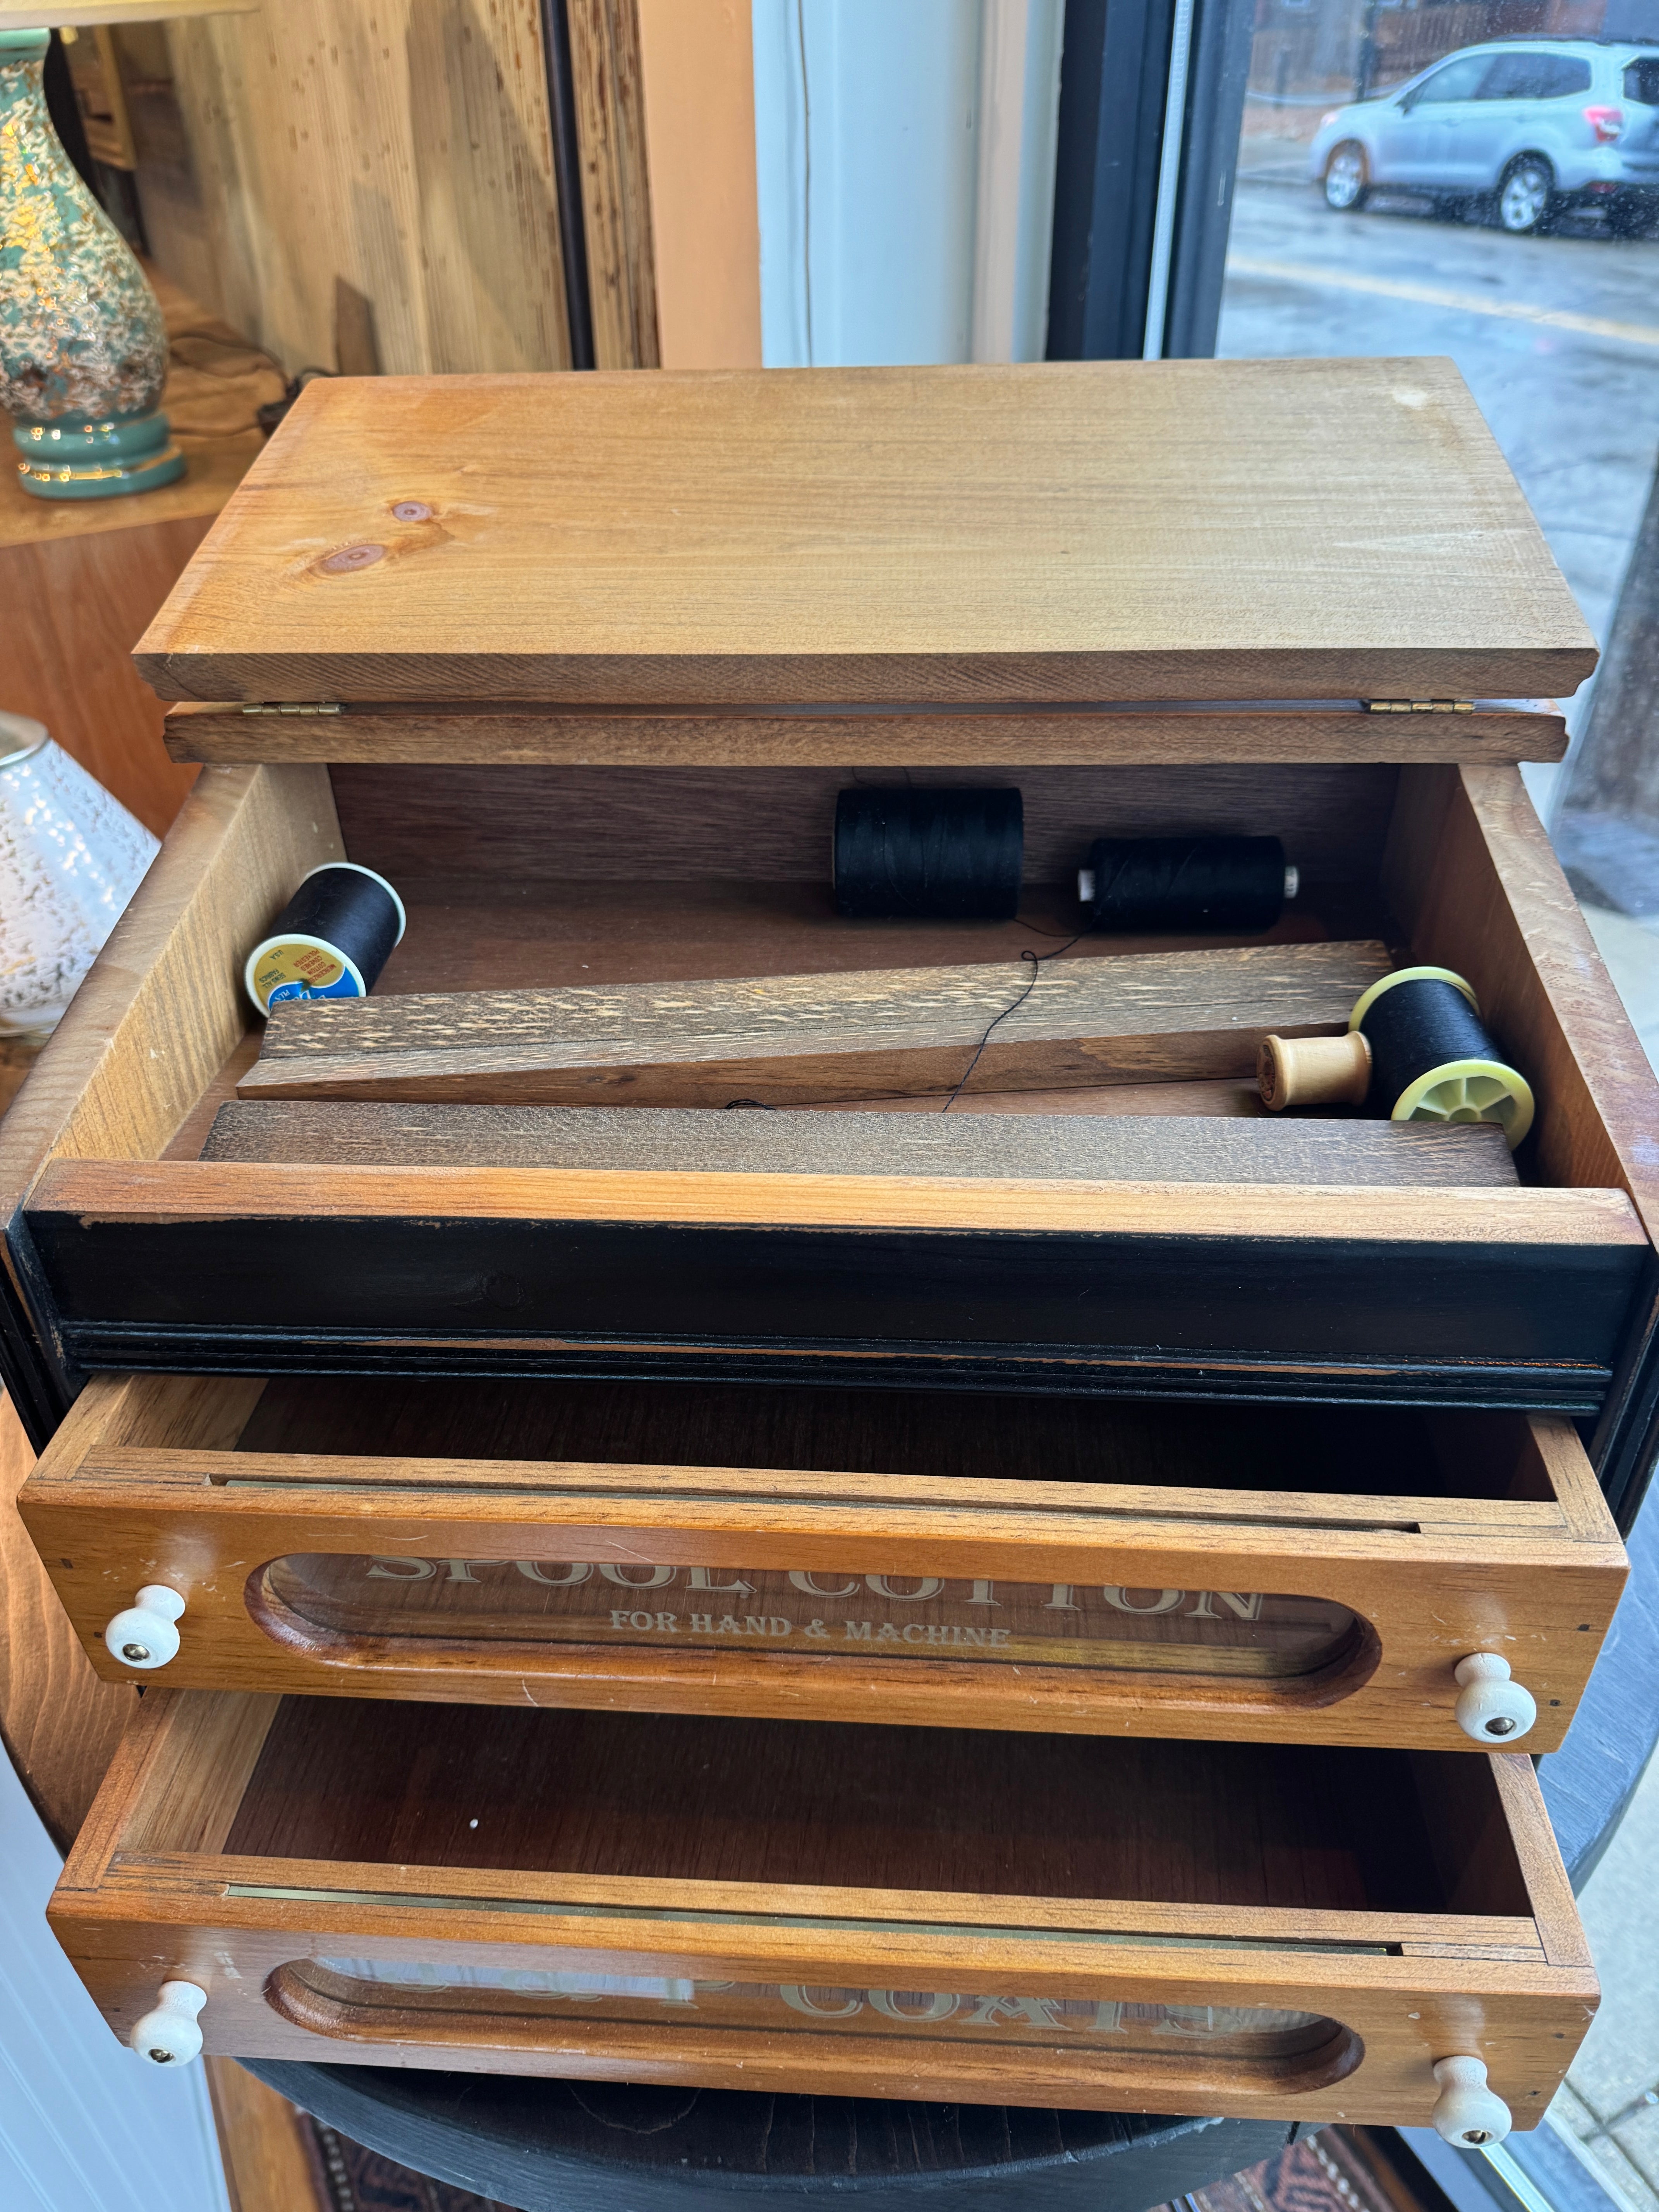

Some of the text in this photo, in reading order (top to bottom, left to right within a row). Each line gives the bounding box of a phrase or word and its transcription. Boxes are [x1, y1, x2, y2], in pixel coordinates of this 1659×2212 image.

[294, 949, 321, 967] POLYESTER
[301, 956, 322, 971] COVERED
[259, 969, 280, 982] FABRICS
[307, 962, 326, 975] COTTON
[610, 1610, 1011, 1648] FOR HAND & MACHINE
